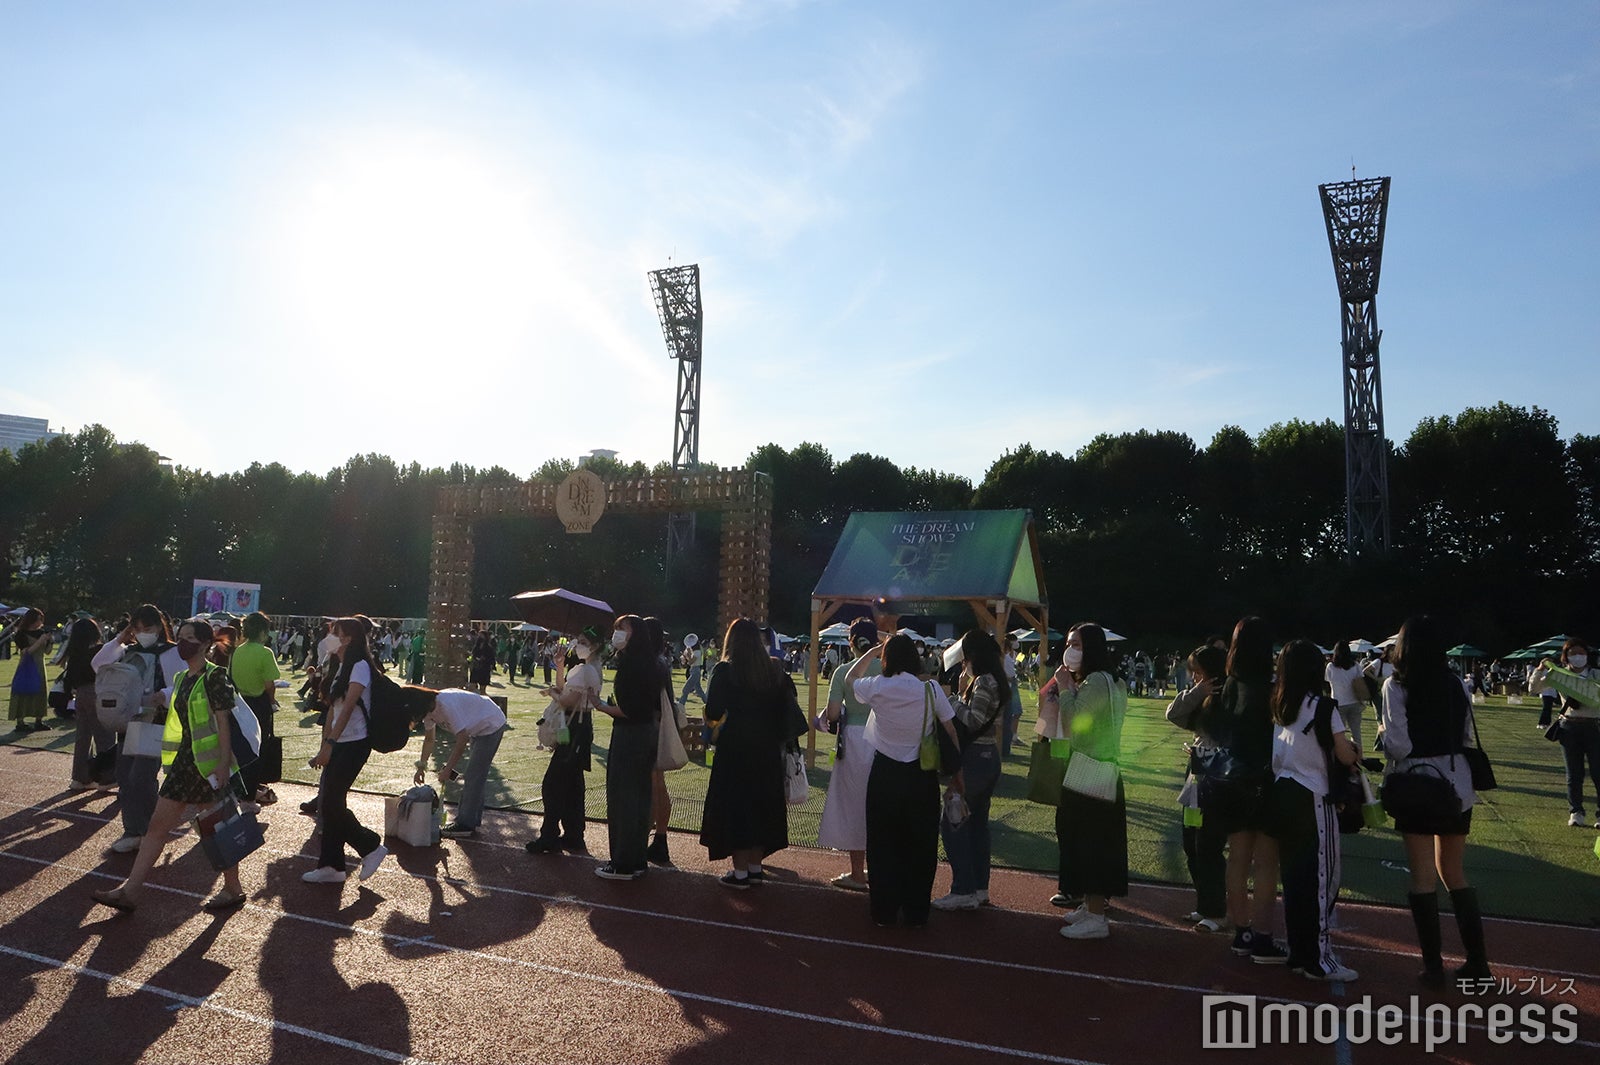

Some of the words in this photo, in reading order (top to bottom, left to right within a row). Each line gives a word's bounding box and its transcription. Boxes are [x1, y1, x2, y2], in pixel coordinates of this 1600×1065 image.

[567, 521, 590, 531] ZONE
[892, 524, 919, 534] THE
[922, 522, 976, 534] DREAM
[902, 534, 942, 544] SHOW
[945, 533, 956, 543] 2
